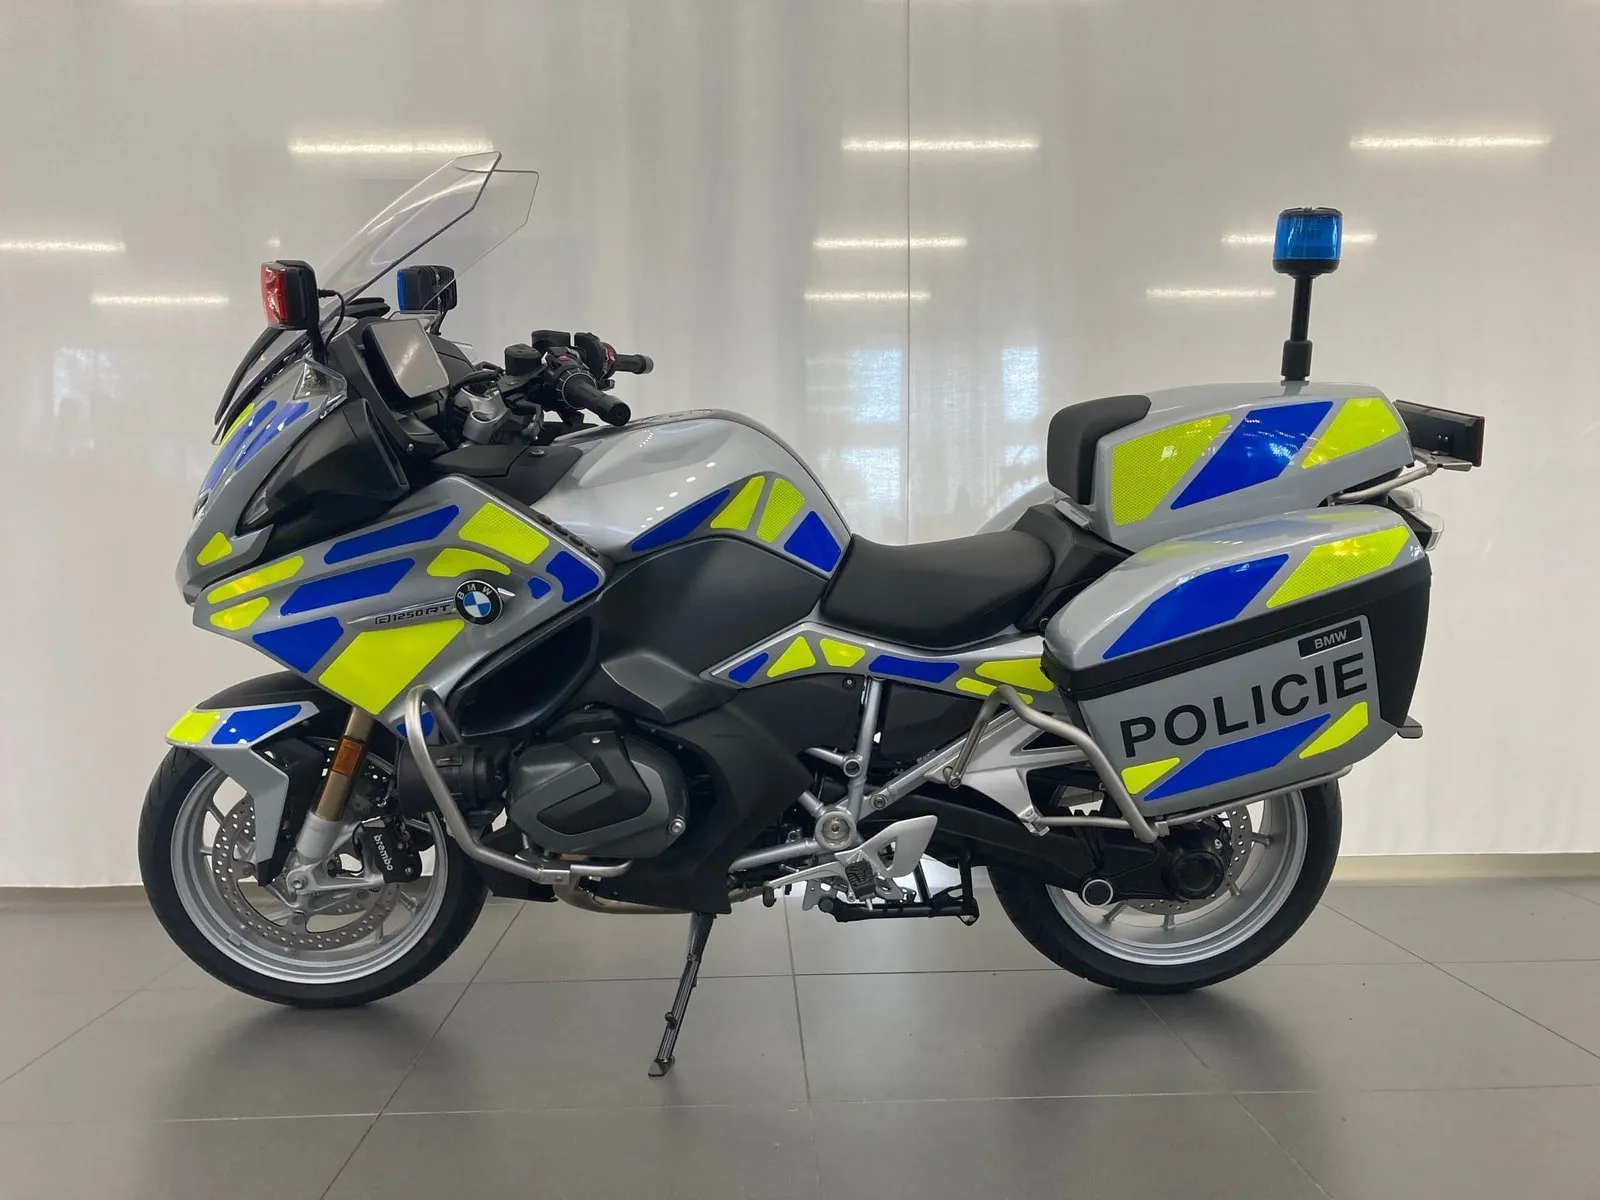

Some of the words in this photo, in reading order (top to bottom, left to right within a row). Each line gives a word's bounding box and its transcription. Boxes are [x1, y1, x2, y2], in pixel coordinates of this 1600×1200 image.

[457, 583, 492, 600] BMW
[1314, 629, 1347, 649] BMW
[1120, 652, 1367, 758] POLICIE
[374, 834, 393, 871] brembo
